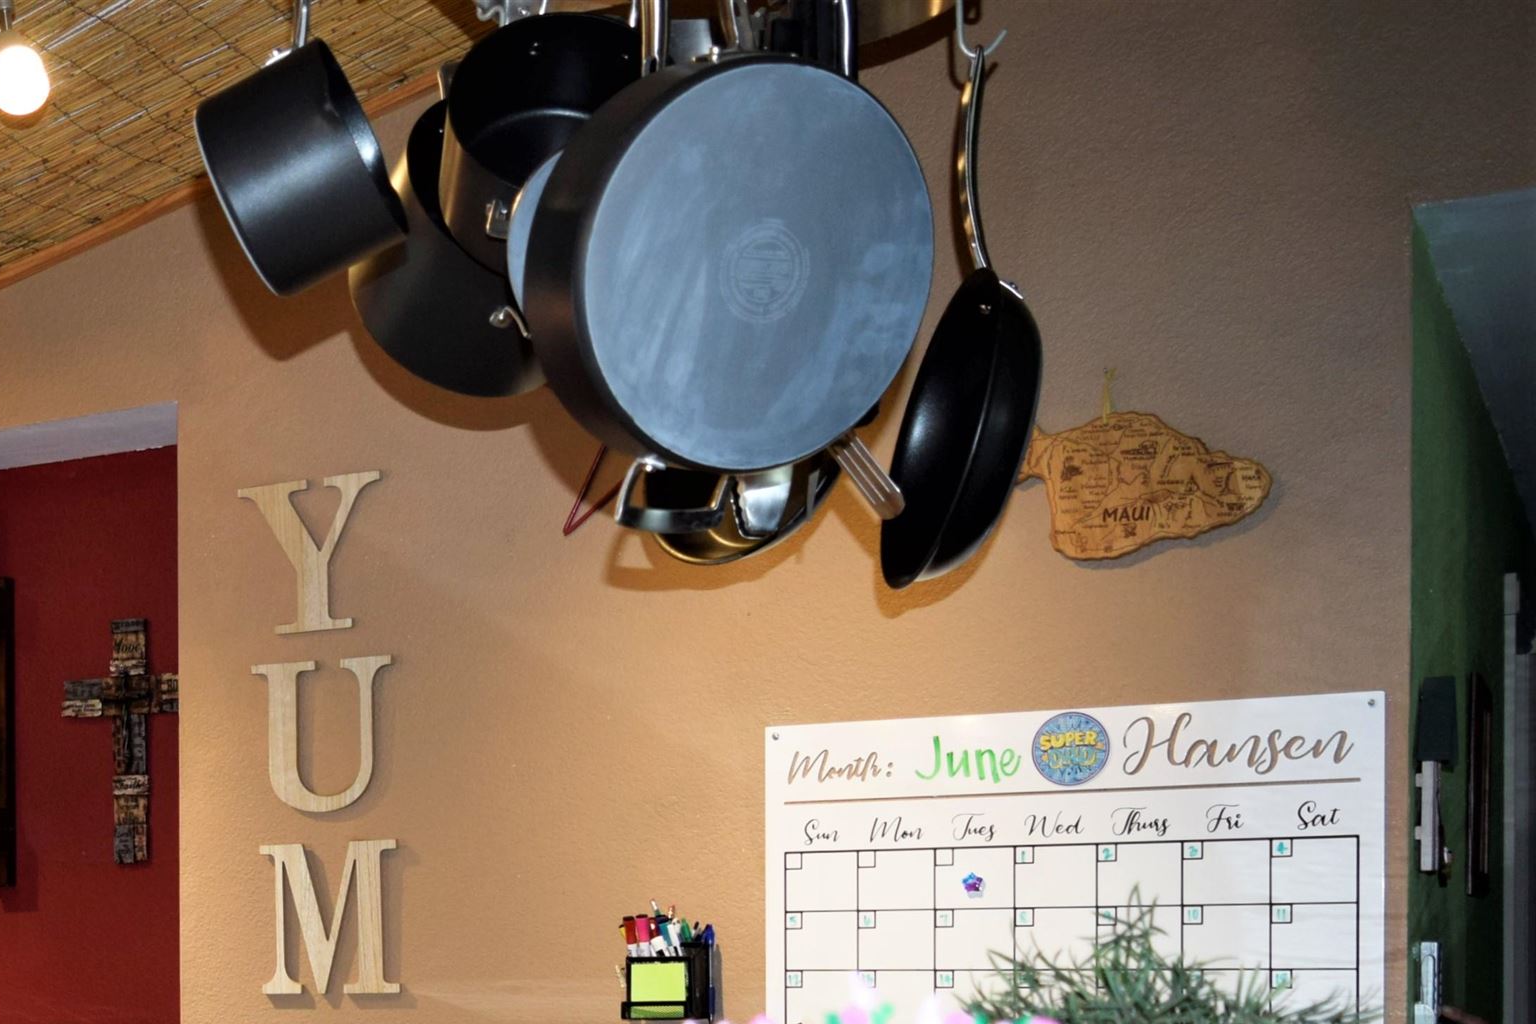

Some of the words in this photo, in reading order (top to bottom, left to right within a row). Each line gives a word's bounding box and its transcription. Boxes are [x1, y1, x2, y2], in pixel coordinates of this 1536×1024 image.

[1102, 506, 1151, 523] MAUI
[1039, 730, 1099, 752] SUPER
[1123, 712, 1355, 777] Hansen
[787, 748, 894, 785] Month:
[915, 735, 1022, 784] June
[804, 818, 841, 847] Sun
[869, 816, 925, 843] Mon
[951, 812, 998, 842] Tues
[1023, 809, 1086, 839] Wed
[1110, 806, 1173, 838] Thurs
[1205, 803, 1245, 833] Fri
[1296, 800, 1342, 831] Sat
[1102, 847, 1113, 861] 2
[1276, 841, 1289, 855] 4
[1187, 909, 1199, 921] 10
[1276, 908, 1287, 920] 11
